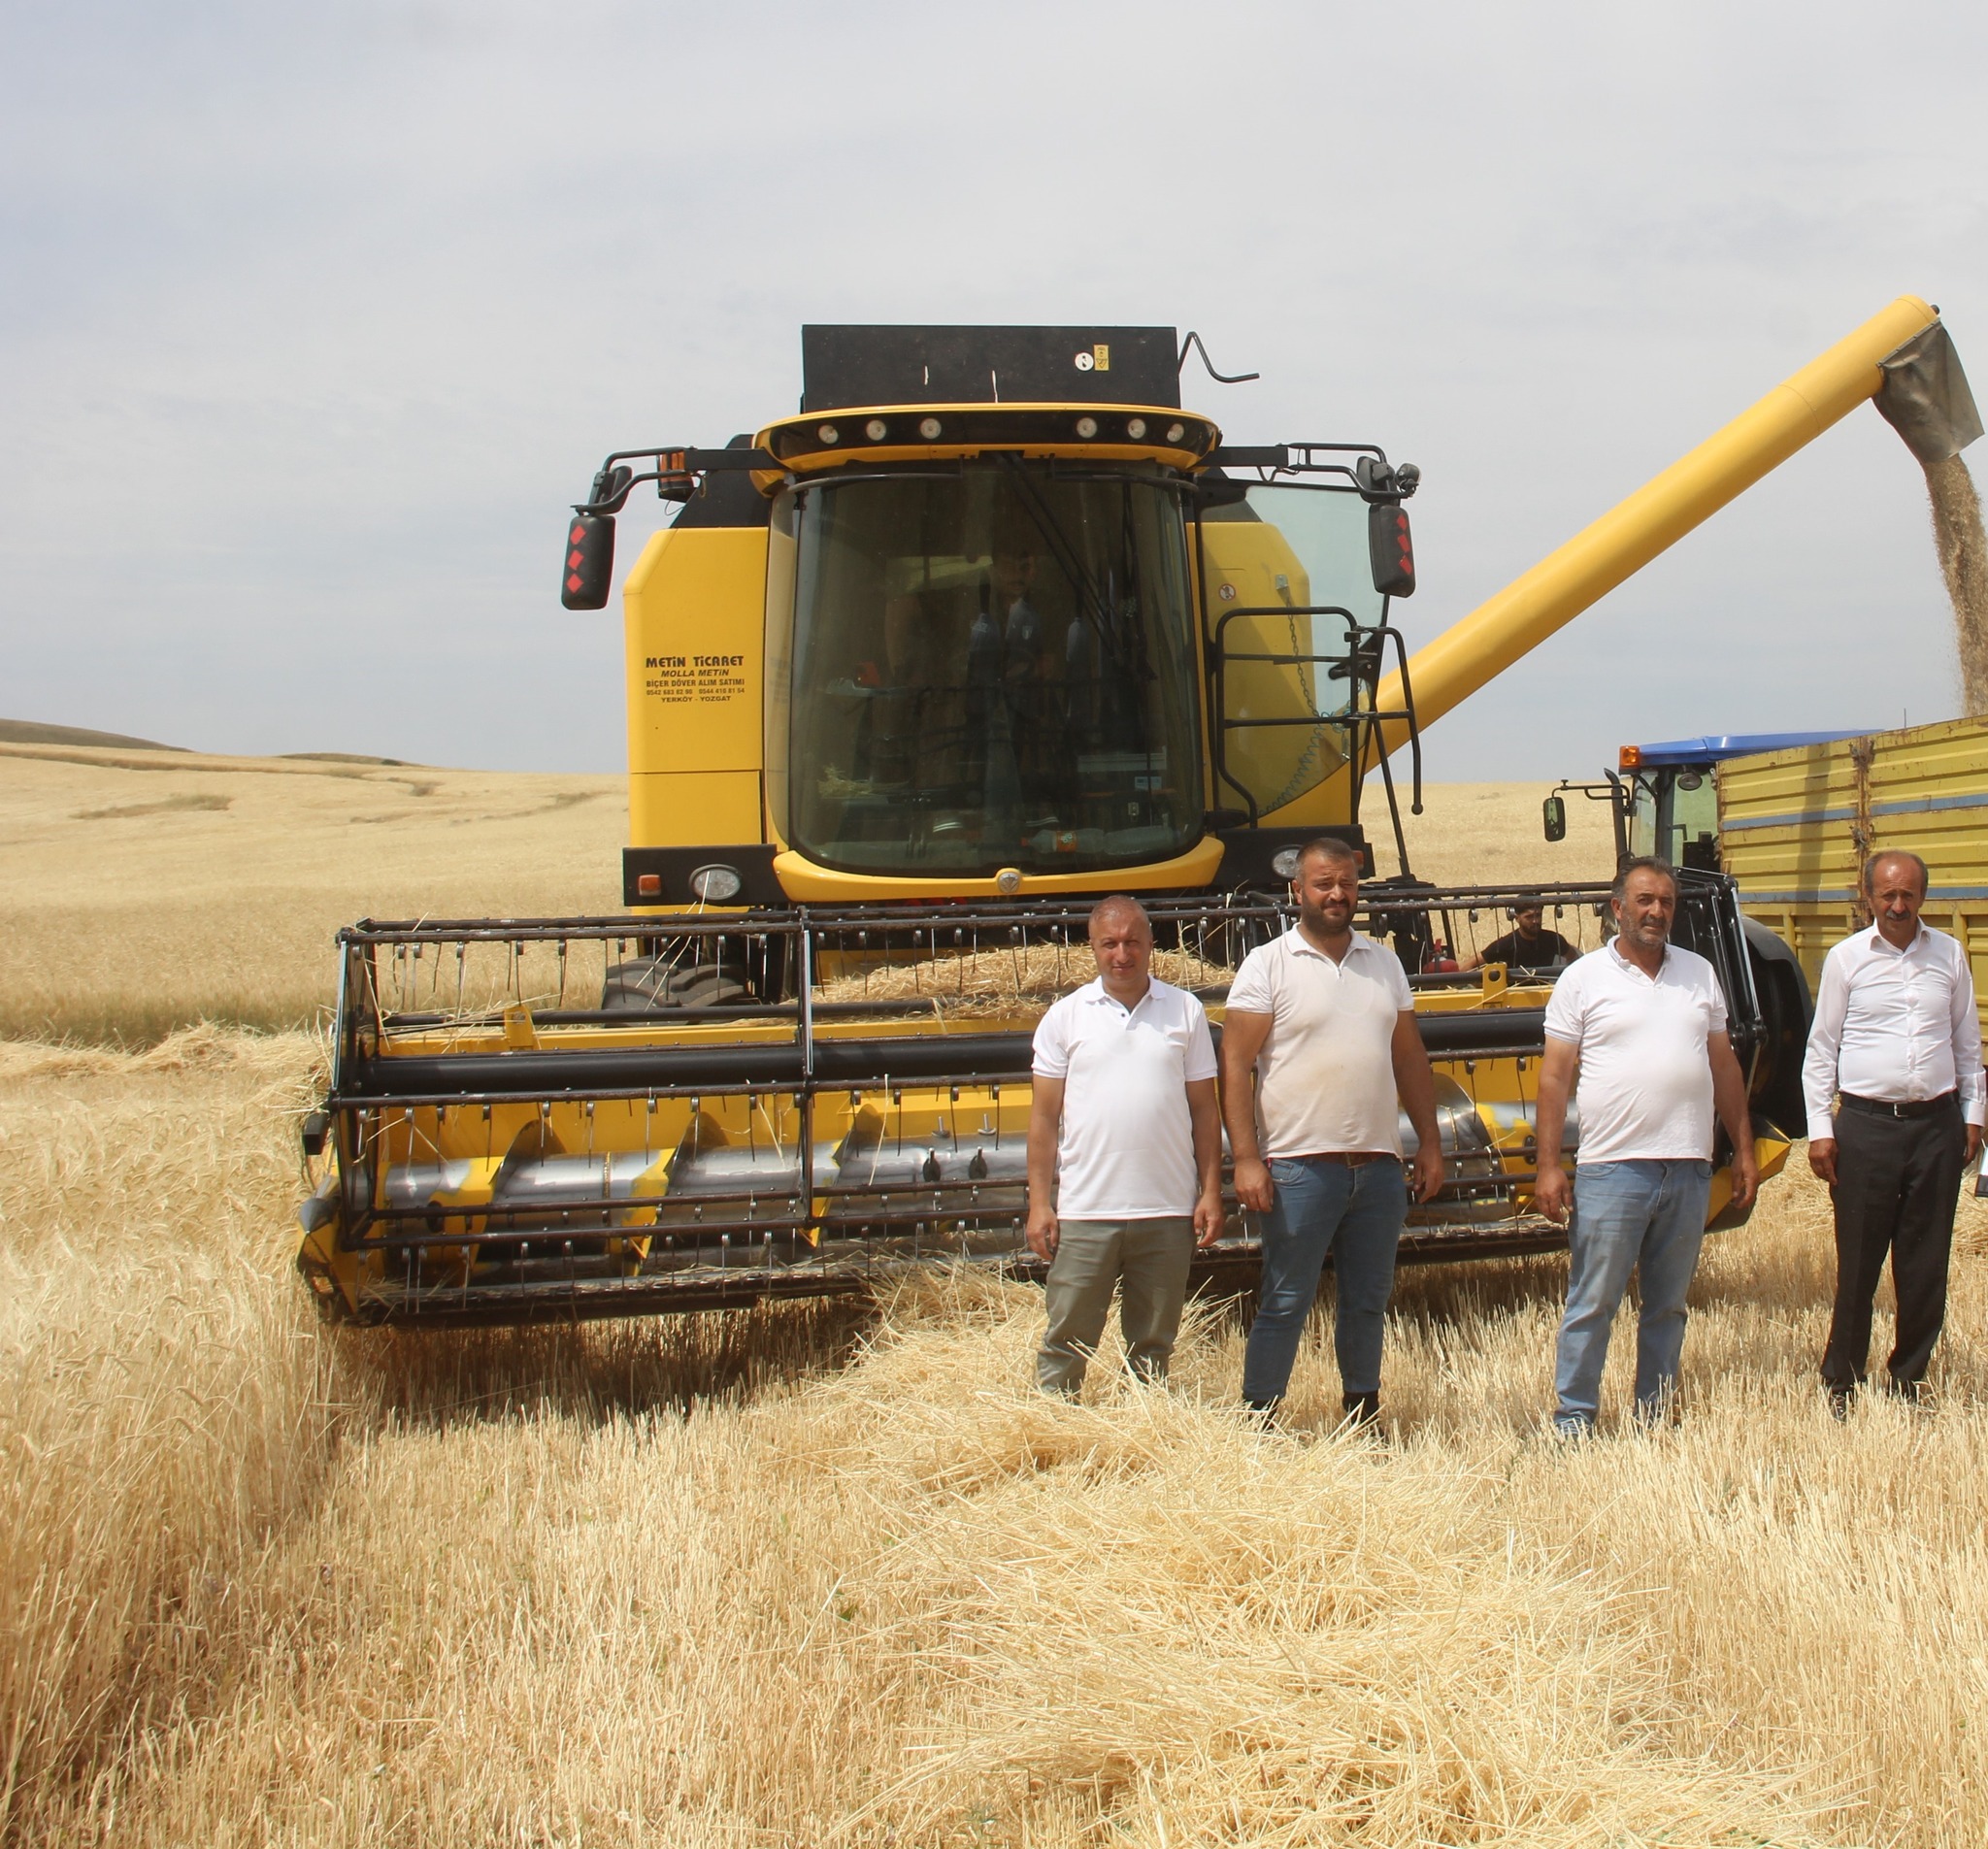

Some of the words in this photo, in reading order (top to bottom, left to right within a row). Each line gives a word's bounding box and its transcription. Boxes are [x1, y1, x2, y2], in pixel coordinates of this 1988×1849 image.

[661, 669, 695, 677] MOLLA
[646, 678, 670, 689] BİÇER
[671, 678, 696, 687] DÖVER
[718, 677, 746, 686] SATIMI
